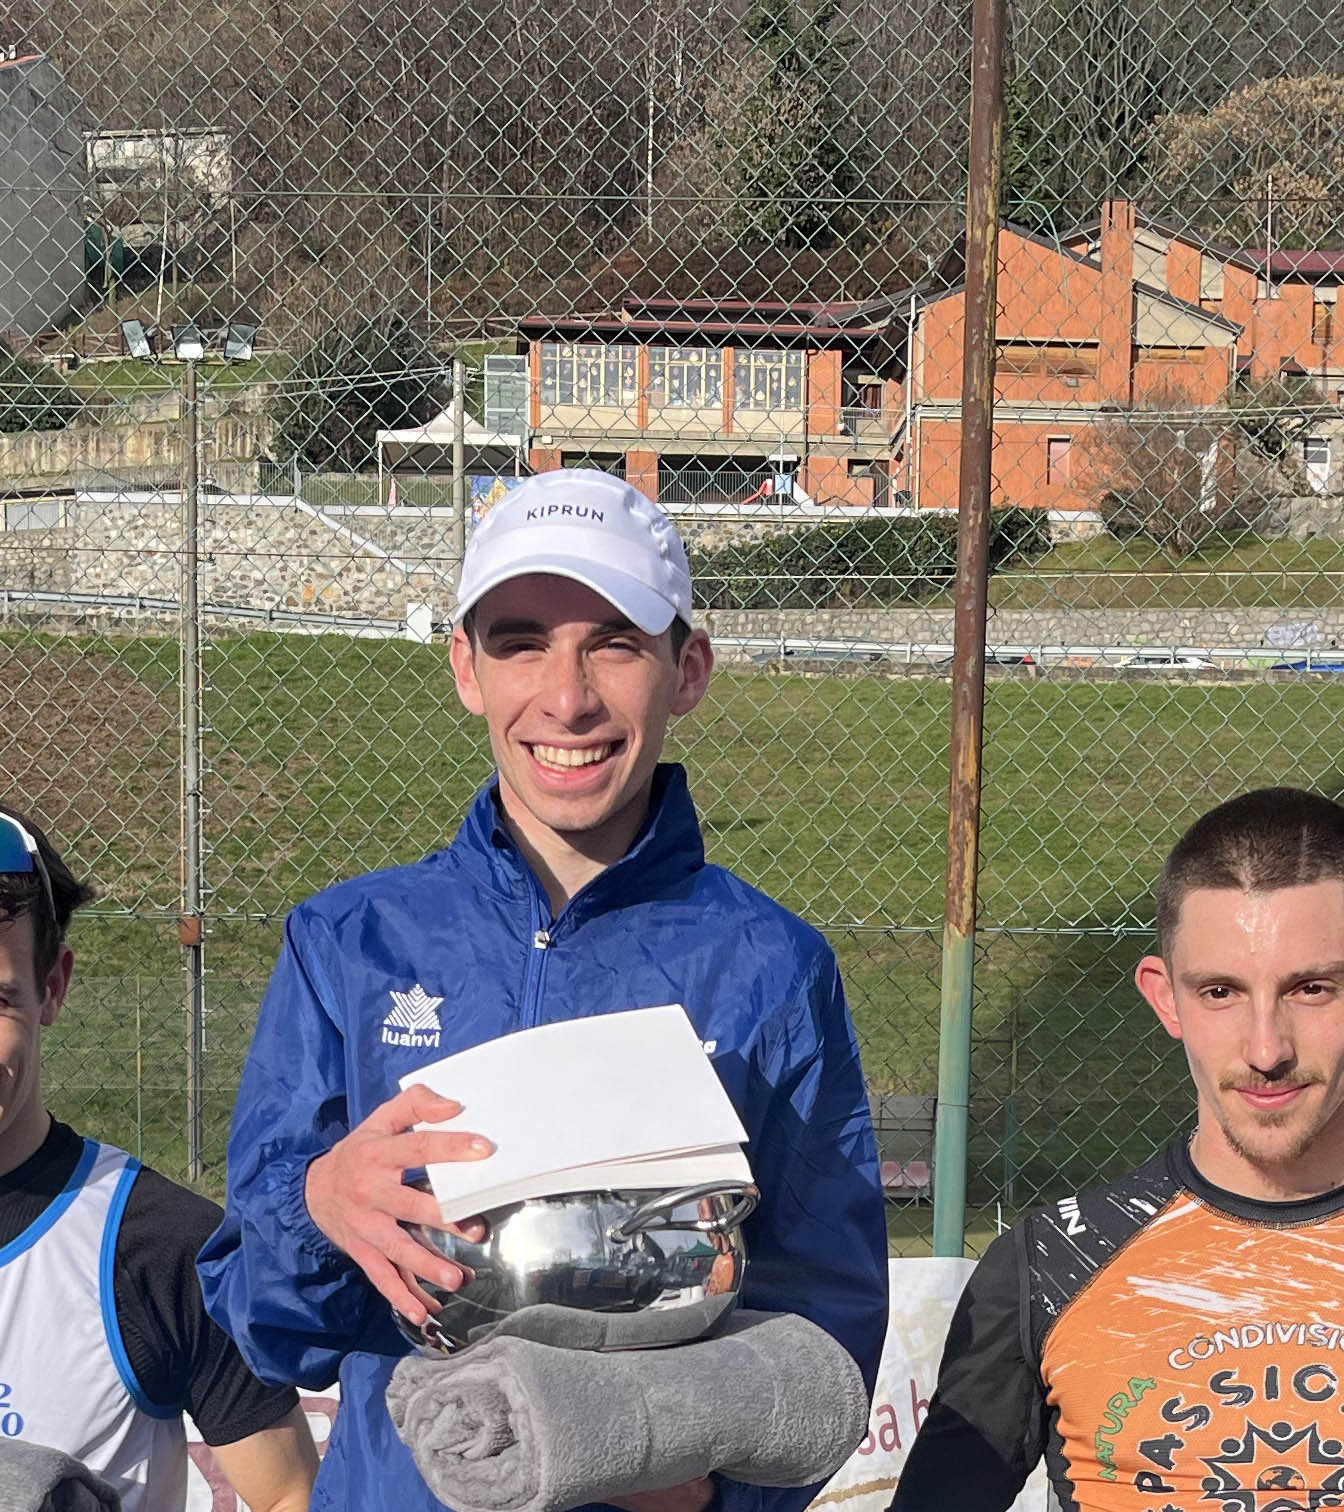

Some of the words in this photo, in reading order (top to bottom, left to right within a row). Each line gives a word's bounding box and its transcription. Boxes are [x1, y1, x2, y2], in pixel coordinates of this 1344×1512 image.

[527, 504, 605, 523] KIPRUN
[382, 1027, 440, 1047] luanvi
[1096, 1376, 1158, 1481] NATURA
